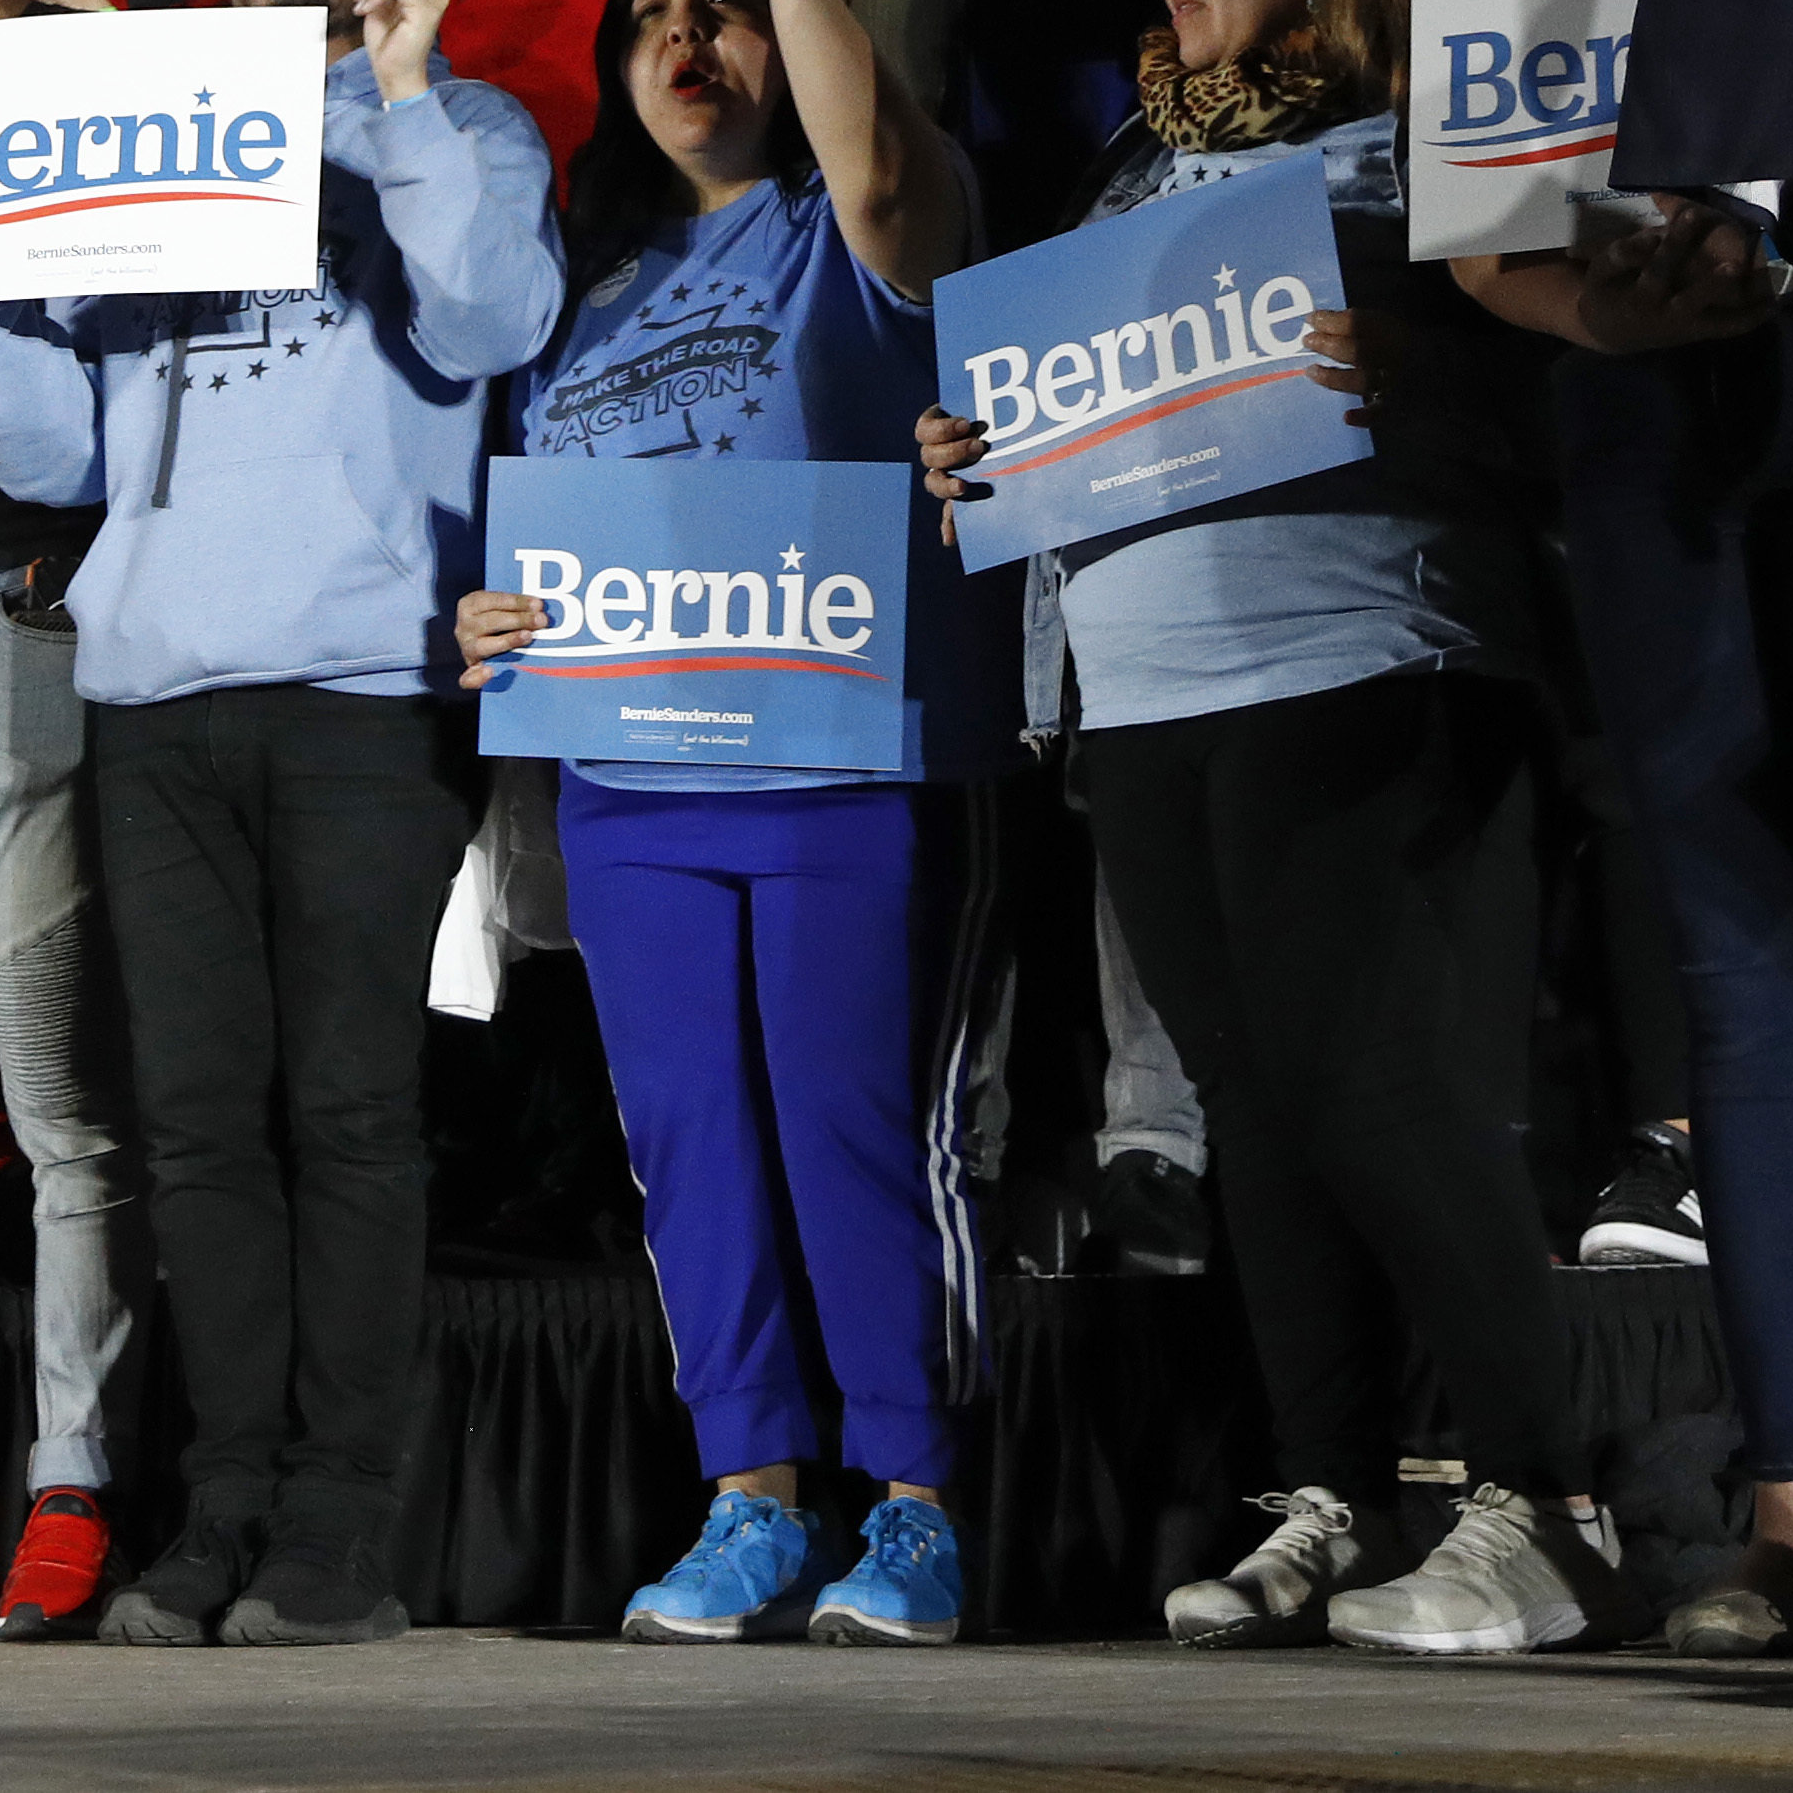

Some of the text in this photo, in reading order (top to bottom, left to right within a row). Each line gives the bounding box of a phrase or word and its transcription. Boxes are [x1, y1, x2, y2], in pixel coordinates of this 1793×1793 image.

[1441, 31, 1633, 131] Ber
[27, 243, 162, 260] BernieSanders.com
[561, 336, 761, 410] MAKE THE ROAD
[965, 263, 1315, 443] Bernie
[554, 355, 749, 454] ACTION
[1090, 446, 1221, 493] BernieSanders.com
[514, 542, 875, 652] Bernie
[620, 706, 754, 724] BernieSanders.com
